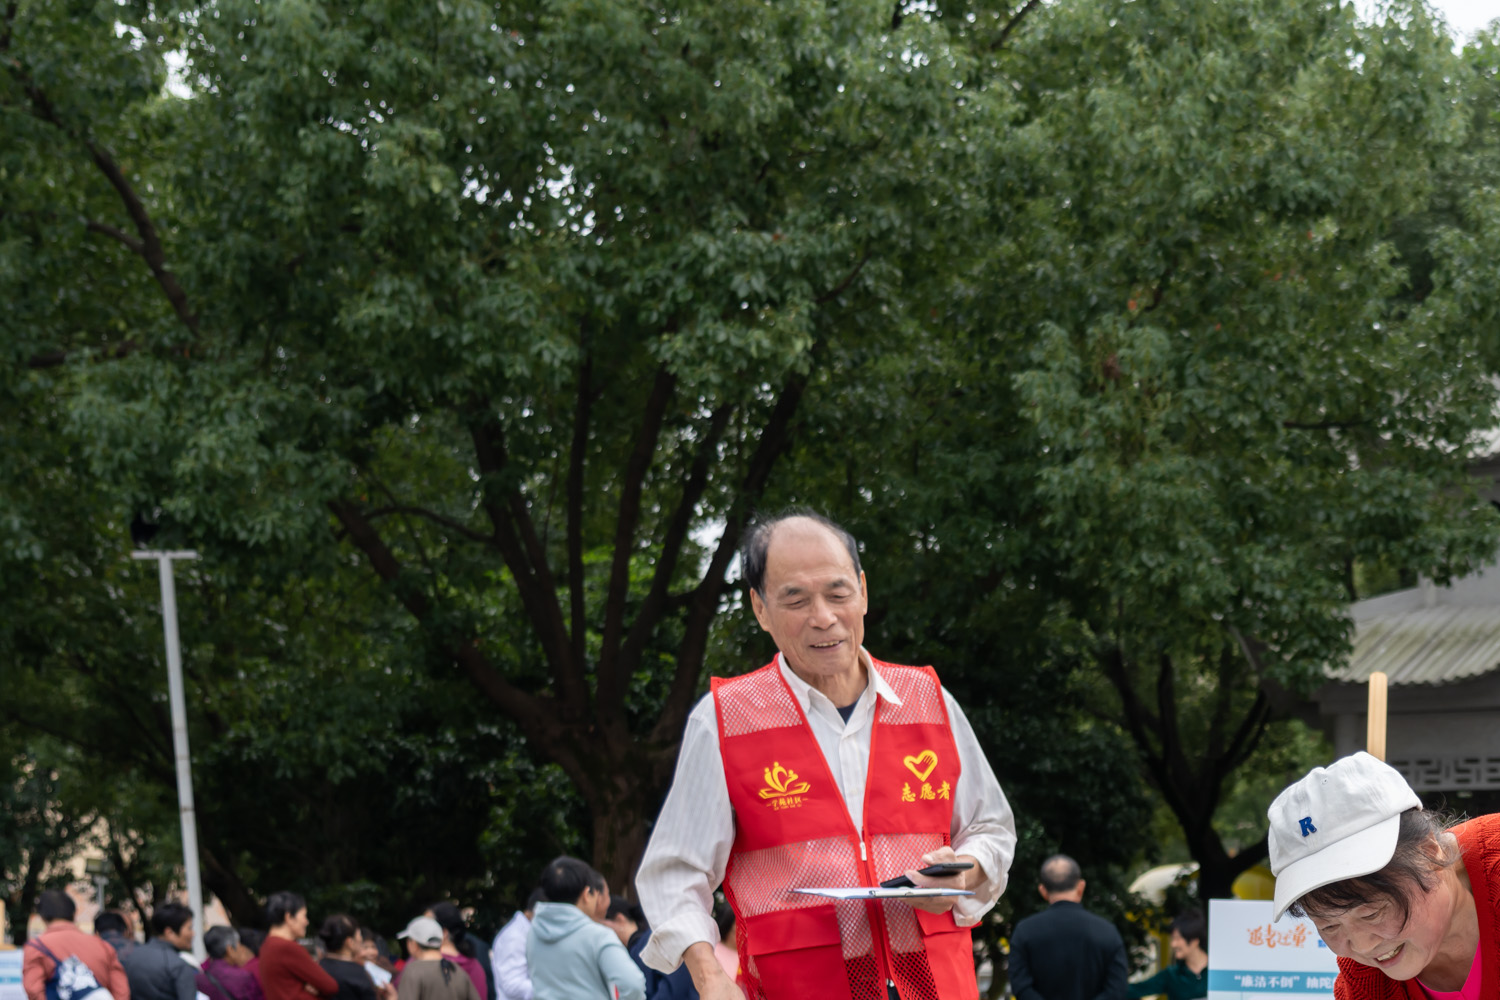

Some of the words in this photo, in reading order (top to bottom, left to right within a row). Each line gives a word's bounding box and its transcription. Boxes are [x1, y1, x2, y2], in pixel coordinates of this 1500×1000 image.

[902, 780, 950, 802] 志愿者
[1298, 816, 1317, 837] R
